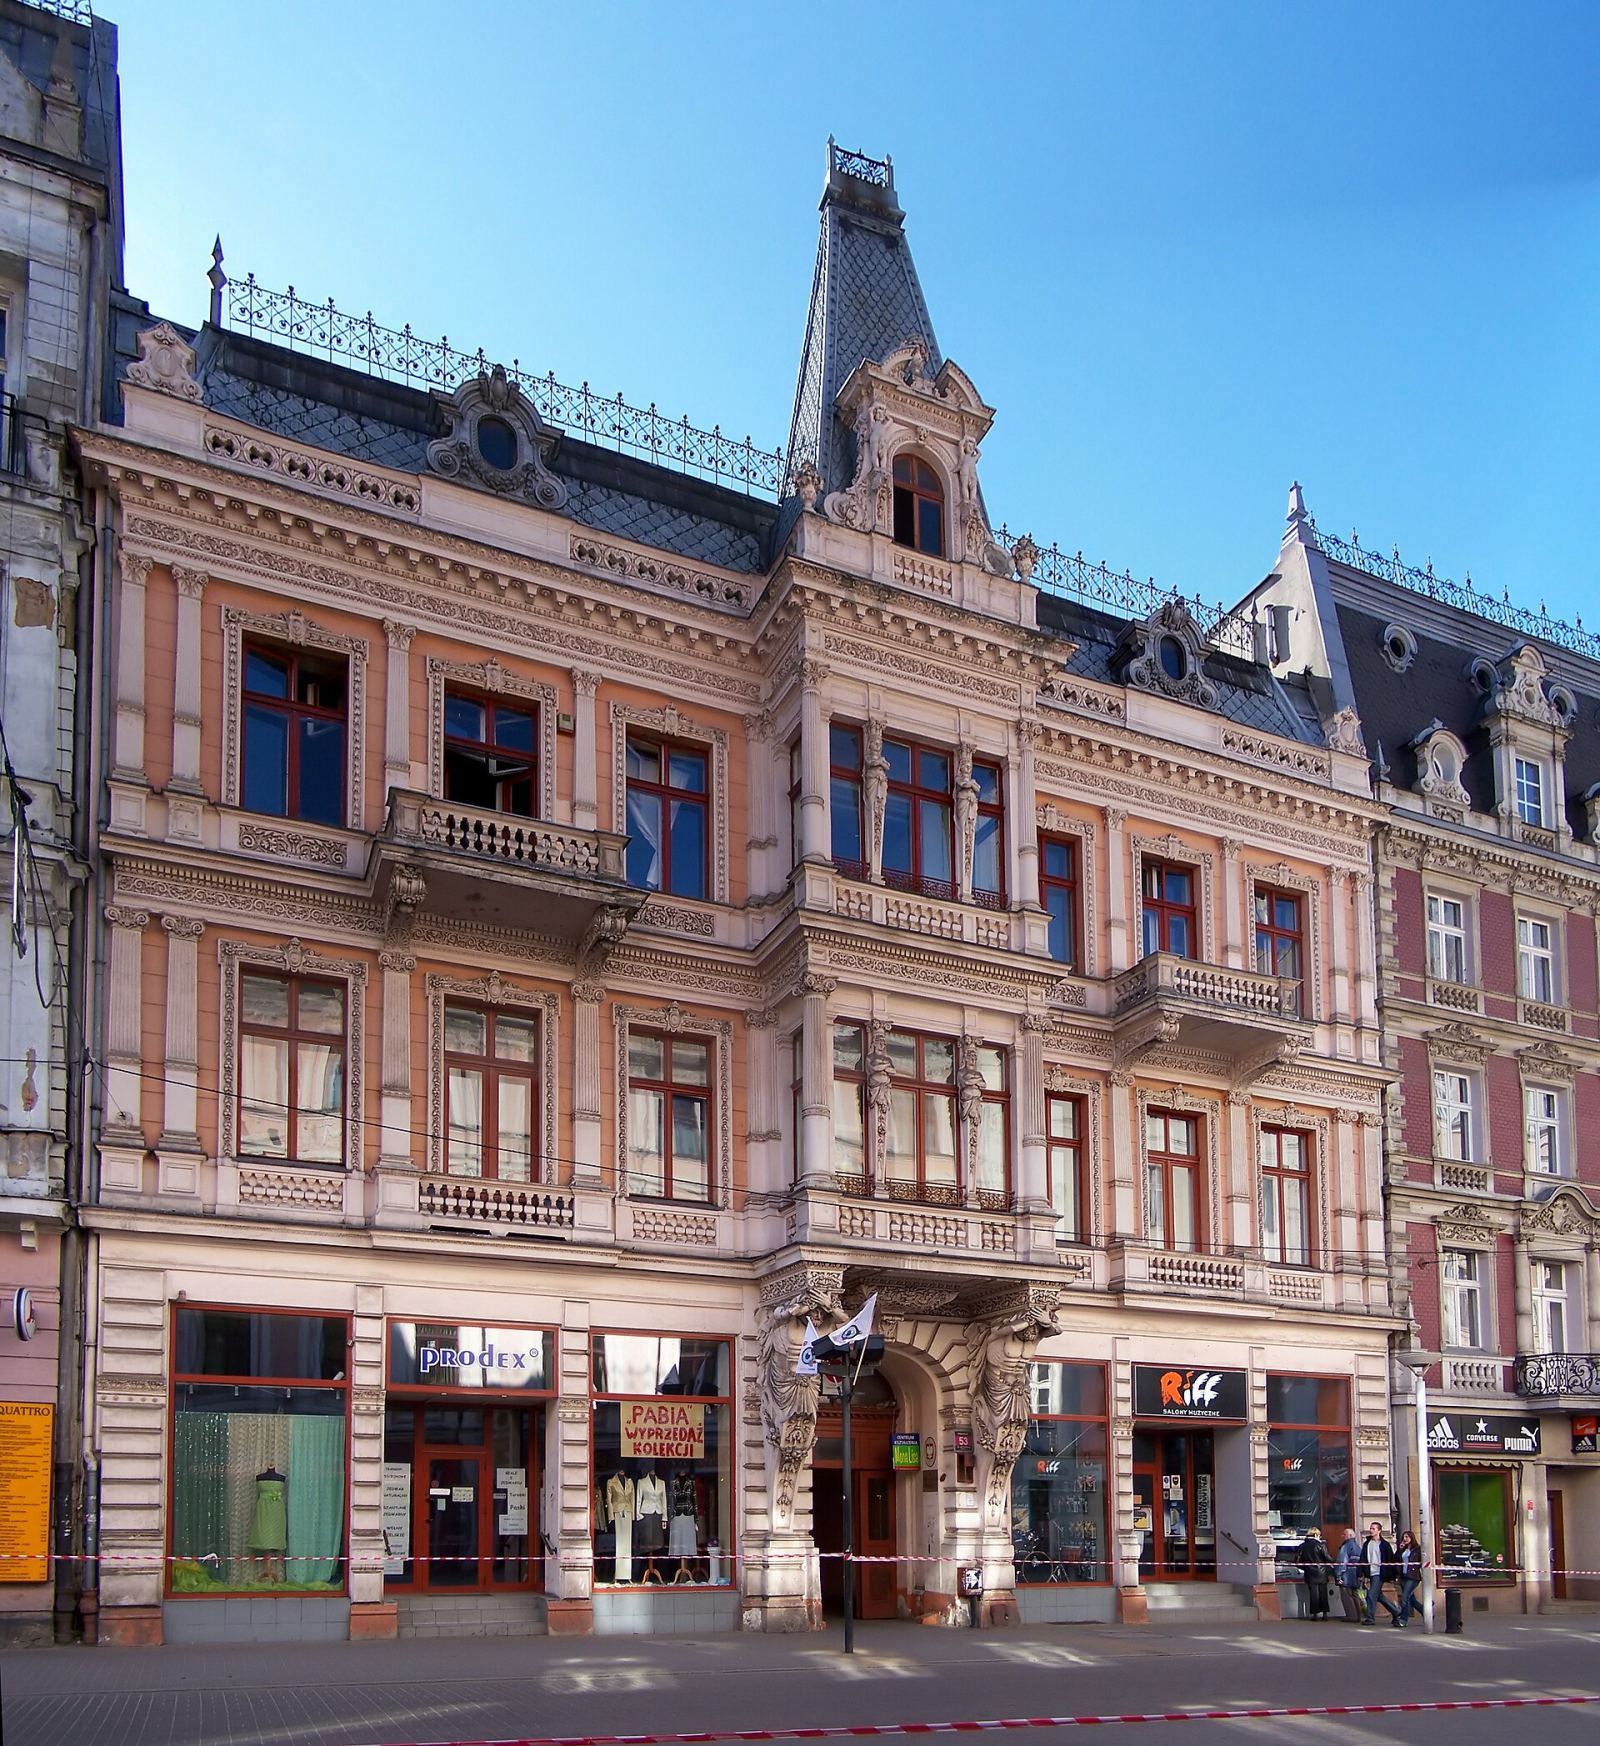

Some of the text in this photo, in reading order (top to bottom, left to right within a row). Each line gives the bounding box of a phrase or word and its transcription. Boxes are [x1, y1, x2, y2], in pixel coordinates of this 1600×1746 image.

[1160, 1370, 1223, 1407] Riff
[1162, 1408, 1220, 1417] SALONY MUZYCZNE
[625, 1422, 703, 1443] WYPRZEDAŻ
[1466, 1434, 1498, 1442] CONVERSE
[958, 1436, 969, 1446] 53
[1427, 1437, 1459, 1449] adidas
[1504, 1437, 1533, 1451] PUMA
[633, 1442, 694, 1457] KOLEKCJI
